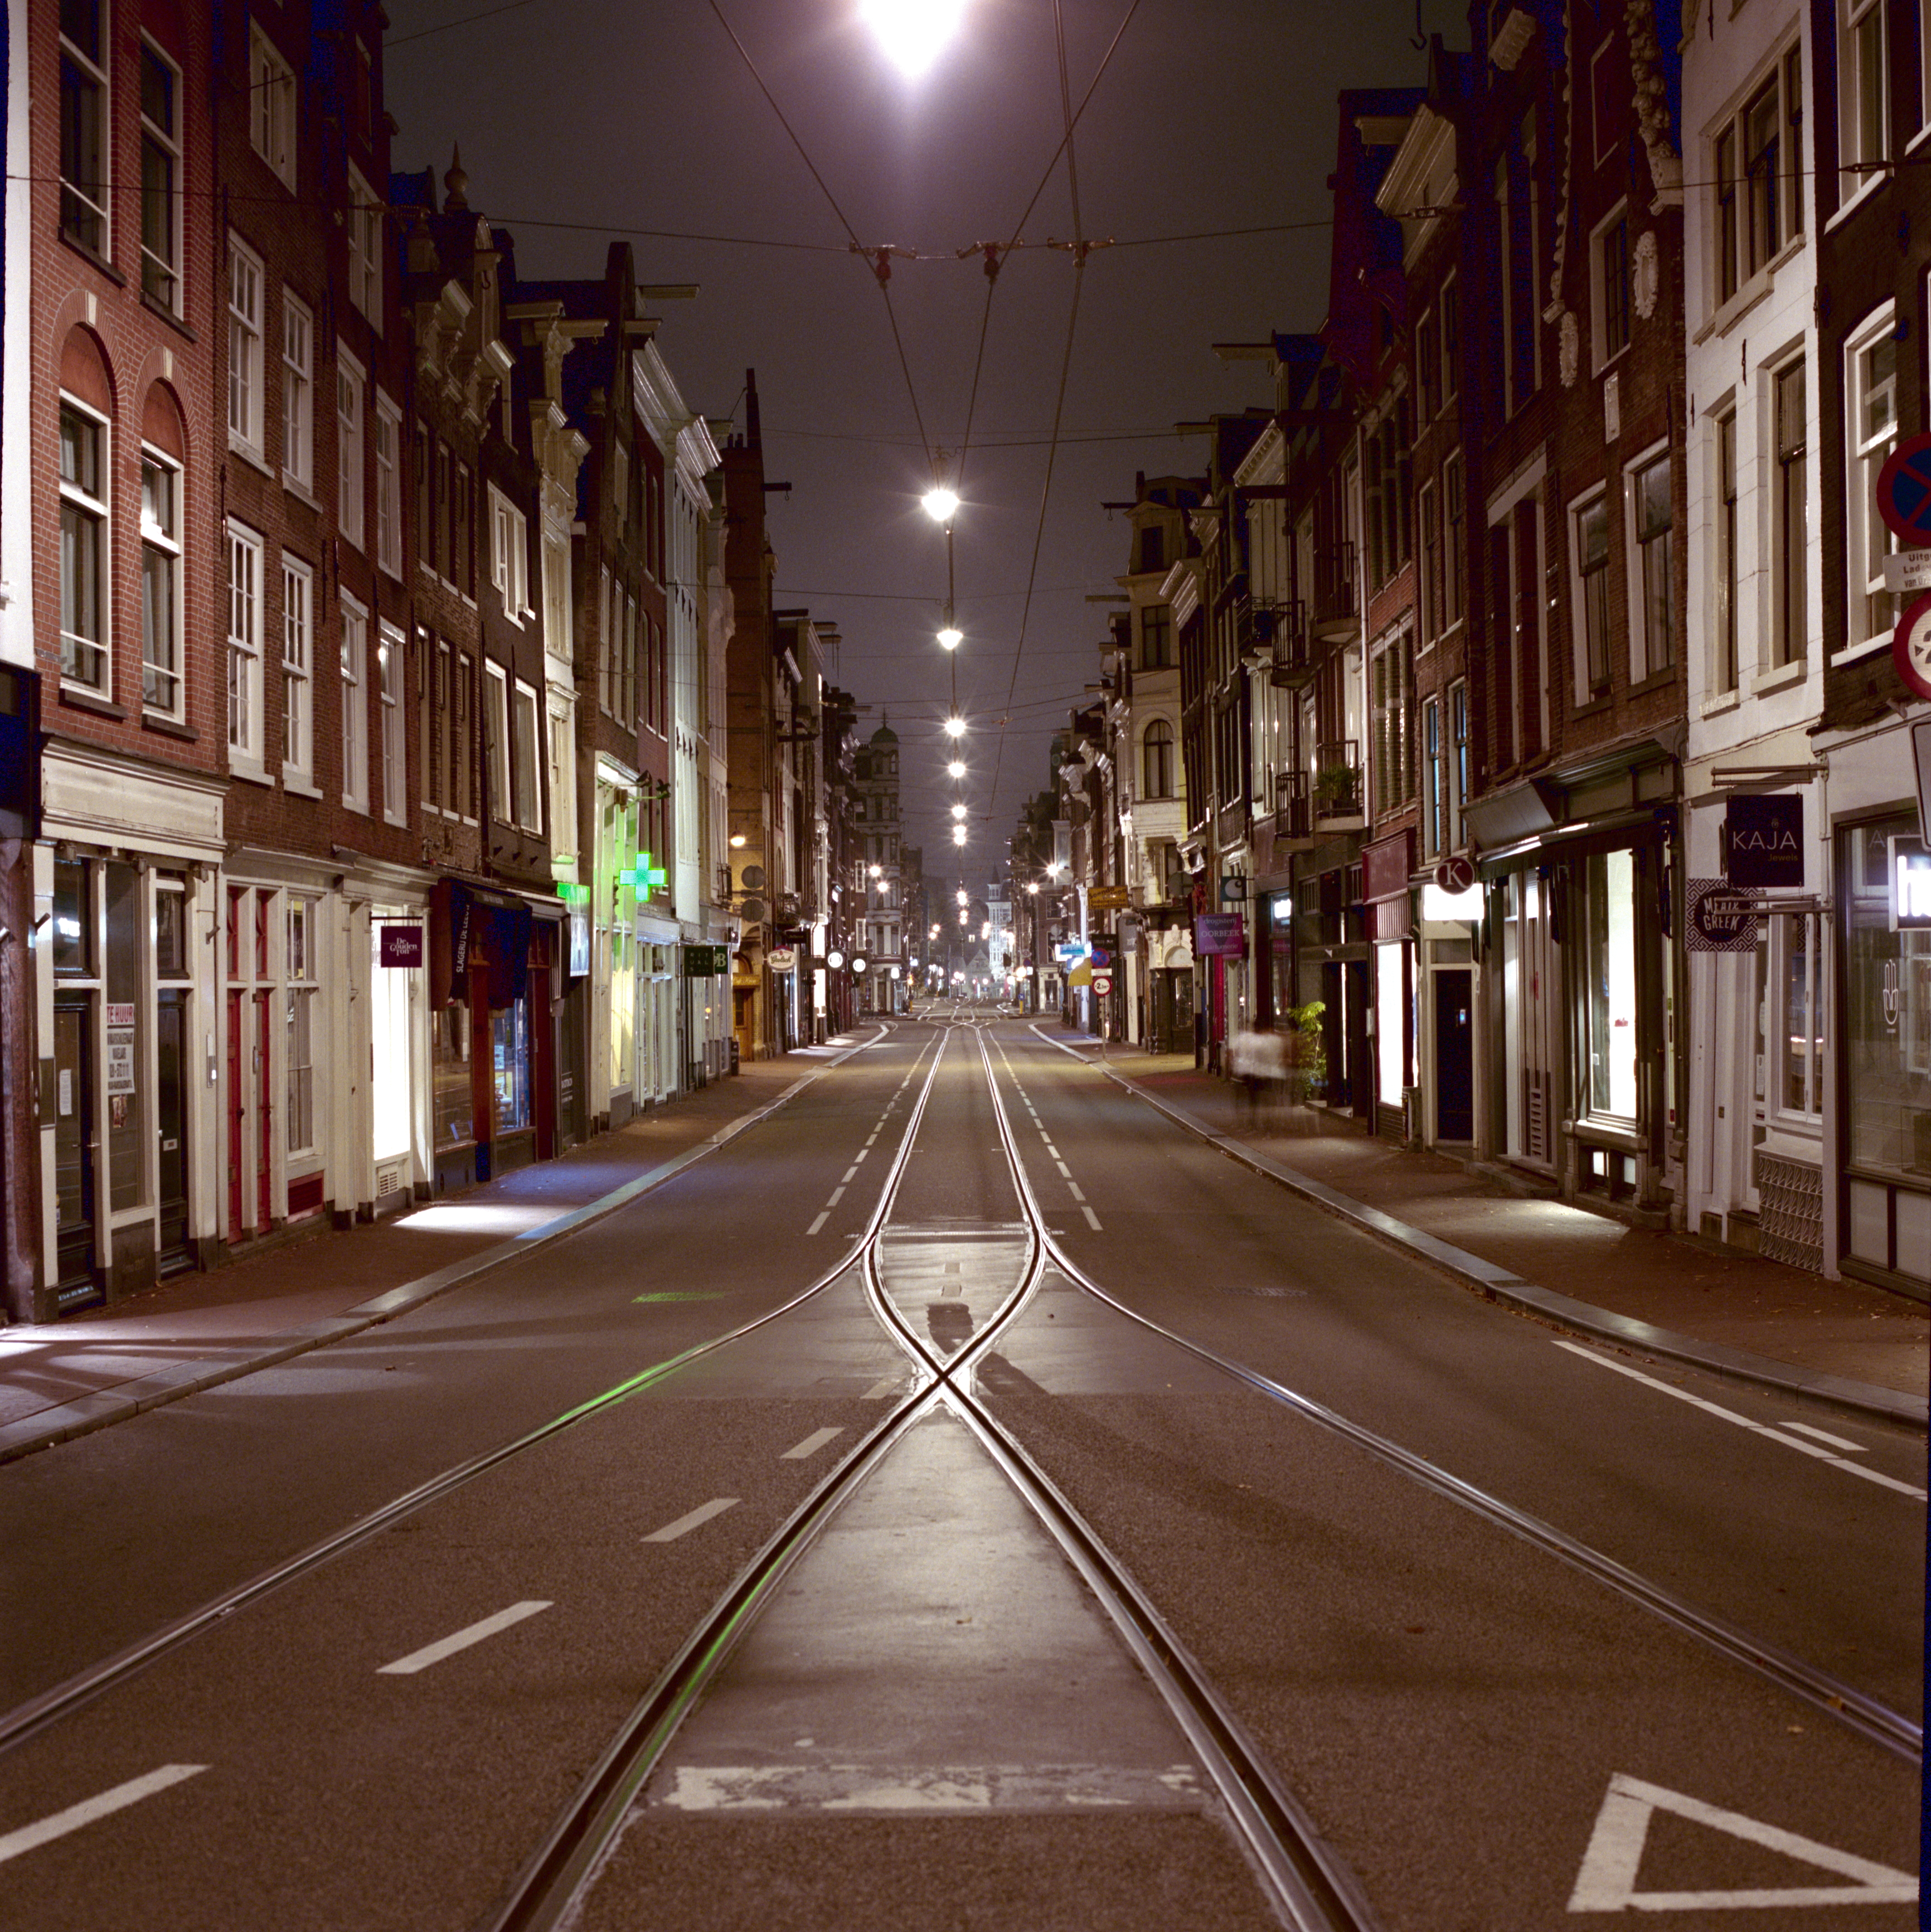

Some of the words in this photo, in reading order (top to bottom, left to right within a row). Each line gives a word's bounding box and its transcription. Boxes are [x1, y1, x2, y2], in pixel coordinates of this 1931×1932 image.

[1908, 553, 1931, 563] Uitg
[1733, 830, 1797, 850] KAJA
[1768, 853, 1798, 861] Jewels
[1442, 862, 1471, 889] K
[1204, 917, 1237, 926] drogisterij
[1703, 914, 1741, 931] GREEK
[460, 929, 467, 940] DE
[1201, 929, 1240, 938] OORBEEK
[390, 942, 418, 952] Gouden
[106, 1005, 114, 1023] TE
[115, 1005, 133, 1023] HUUR
